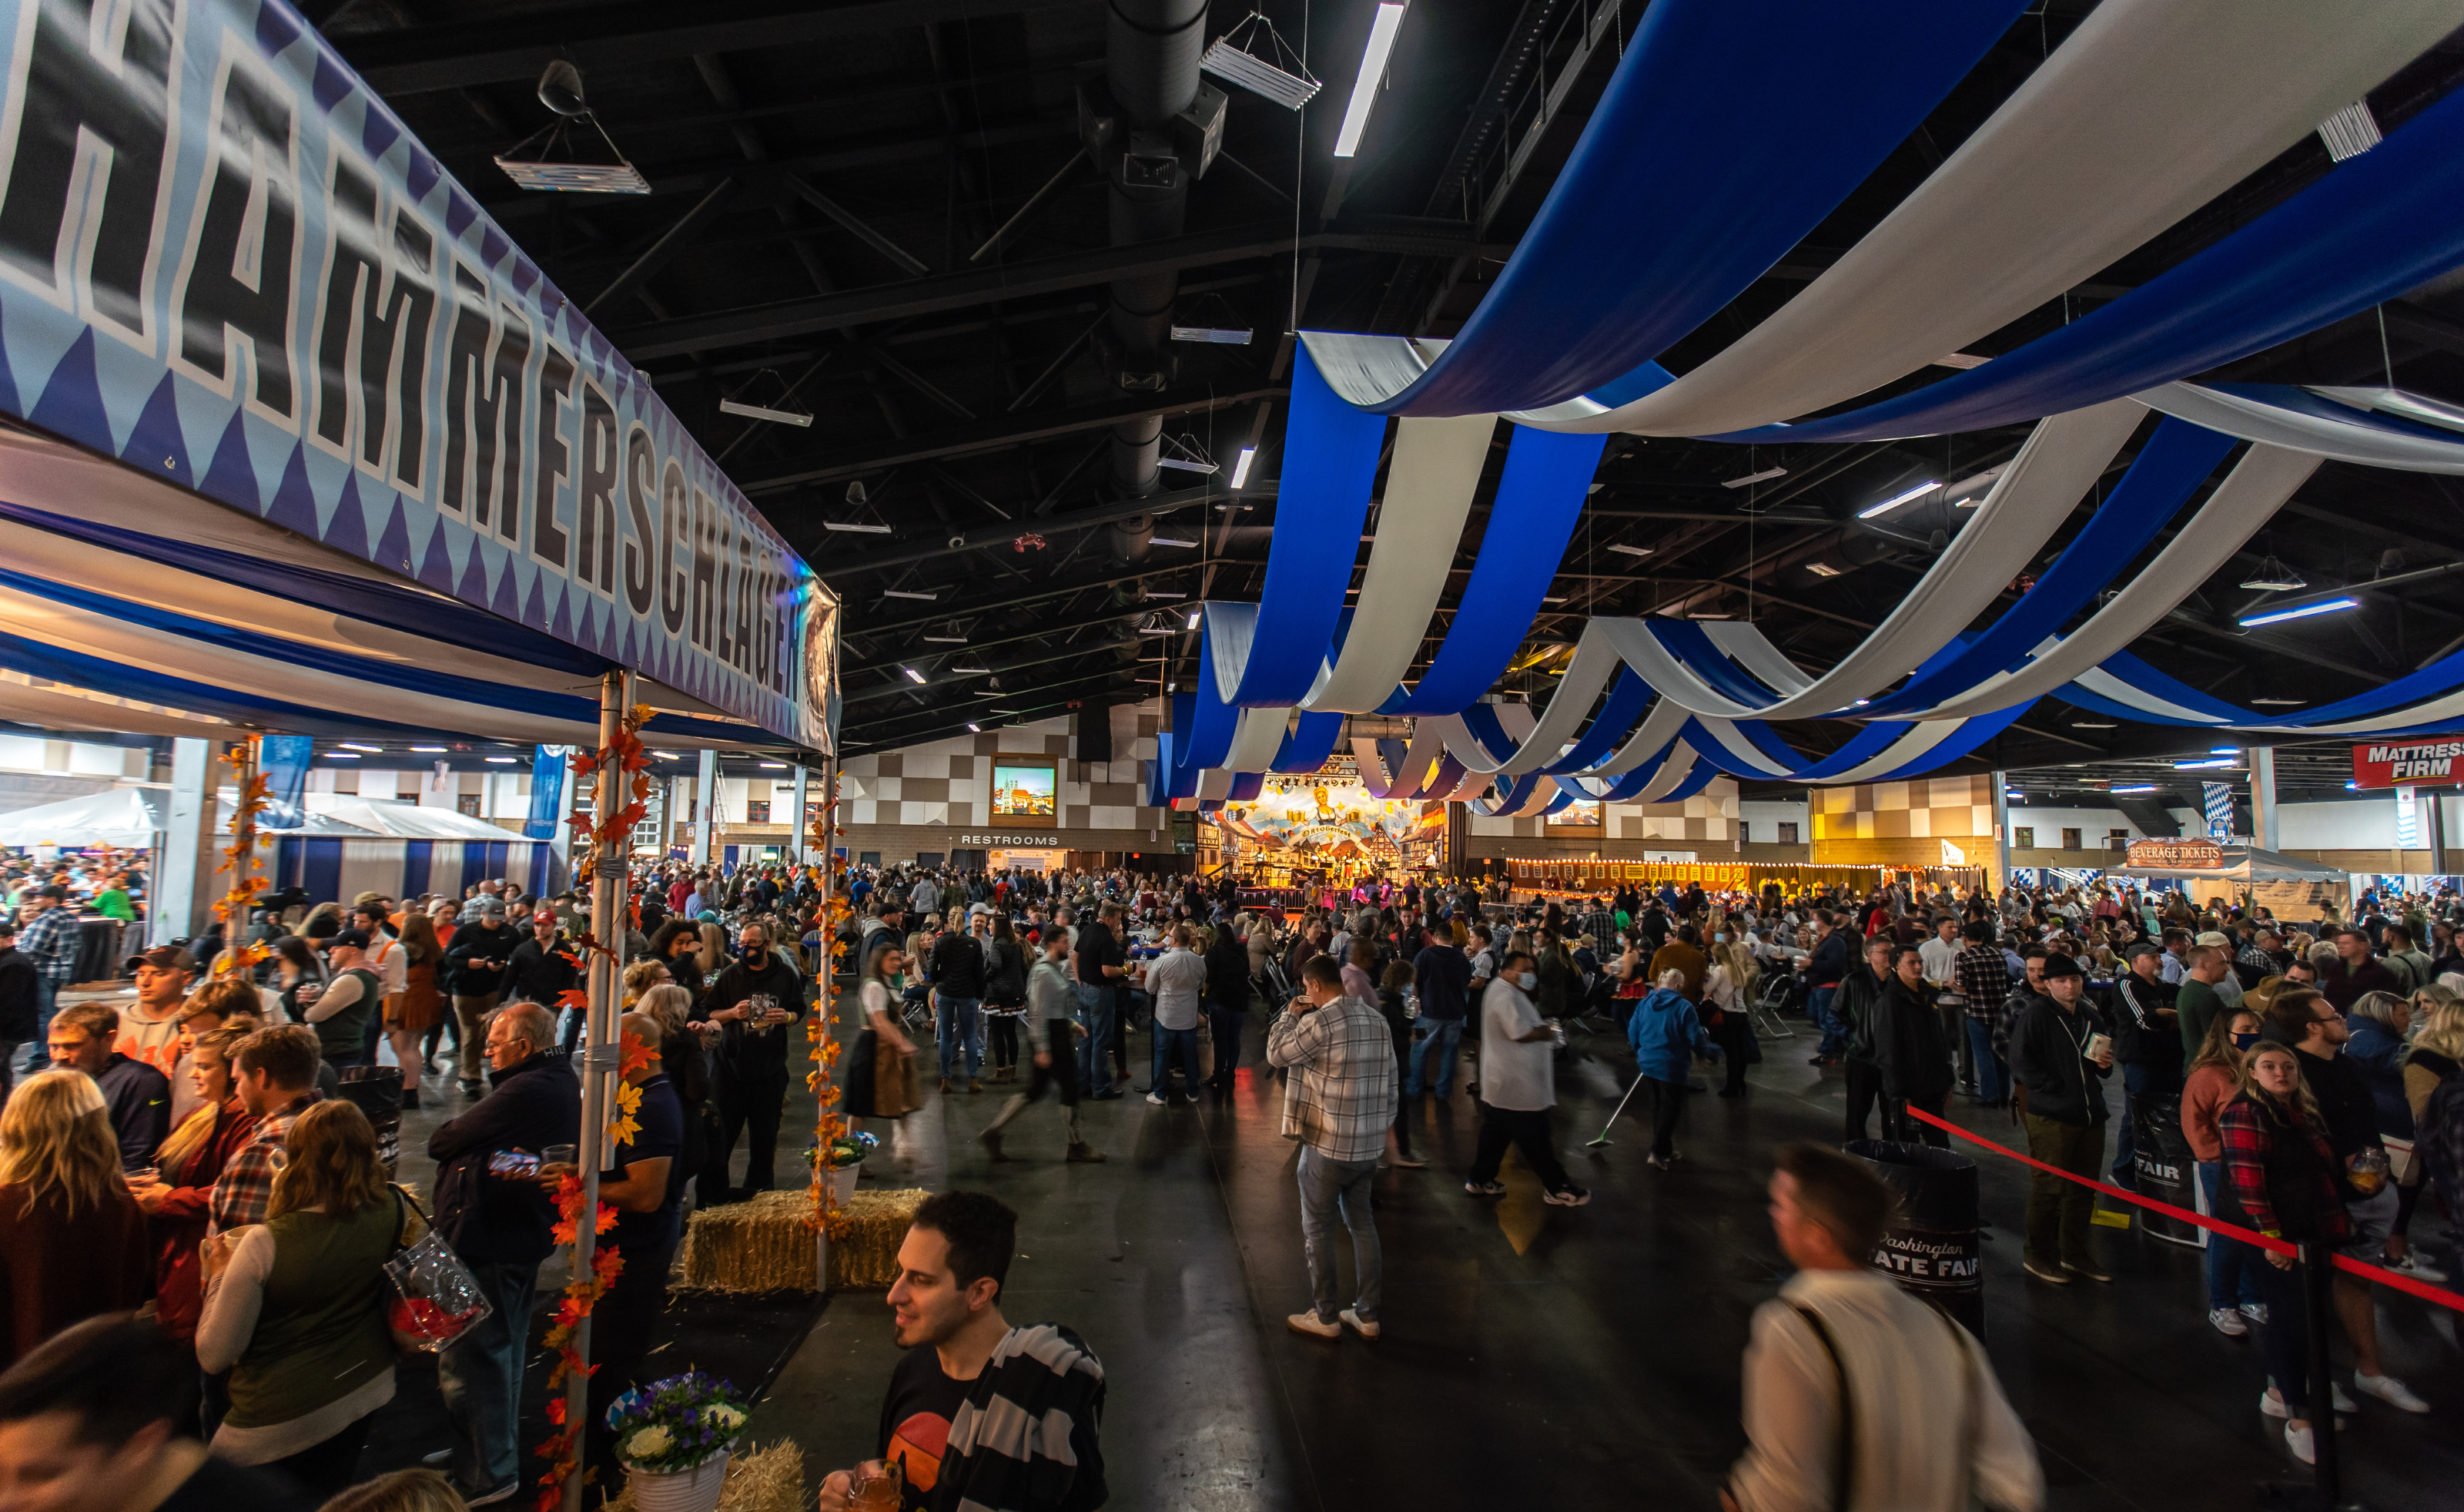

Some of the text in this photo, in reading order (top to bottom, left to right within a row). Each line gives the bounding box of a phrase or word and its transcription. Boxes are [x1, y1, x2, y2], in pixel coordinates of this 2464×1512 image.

[0, 0, 801, 705] HAMMERSCHLAGEN
[2392, 759, 2452, 778] FIRM
[962, 835, 1058, 846] RESTROOMS
[1302, 825, 1351, 838] Oktoberfest
[2130, 846, 2219, 859] BEVERAGE TICKETS
[2137, 1158, 2180, 1180] FAIR
[1874, 1250, 1929, 1276] ATE
